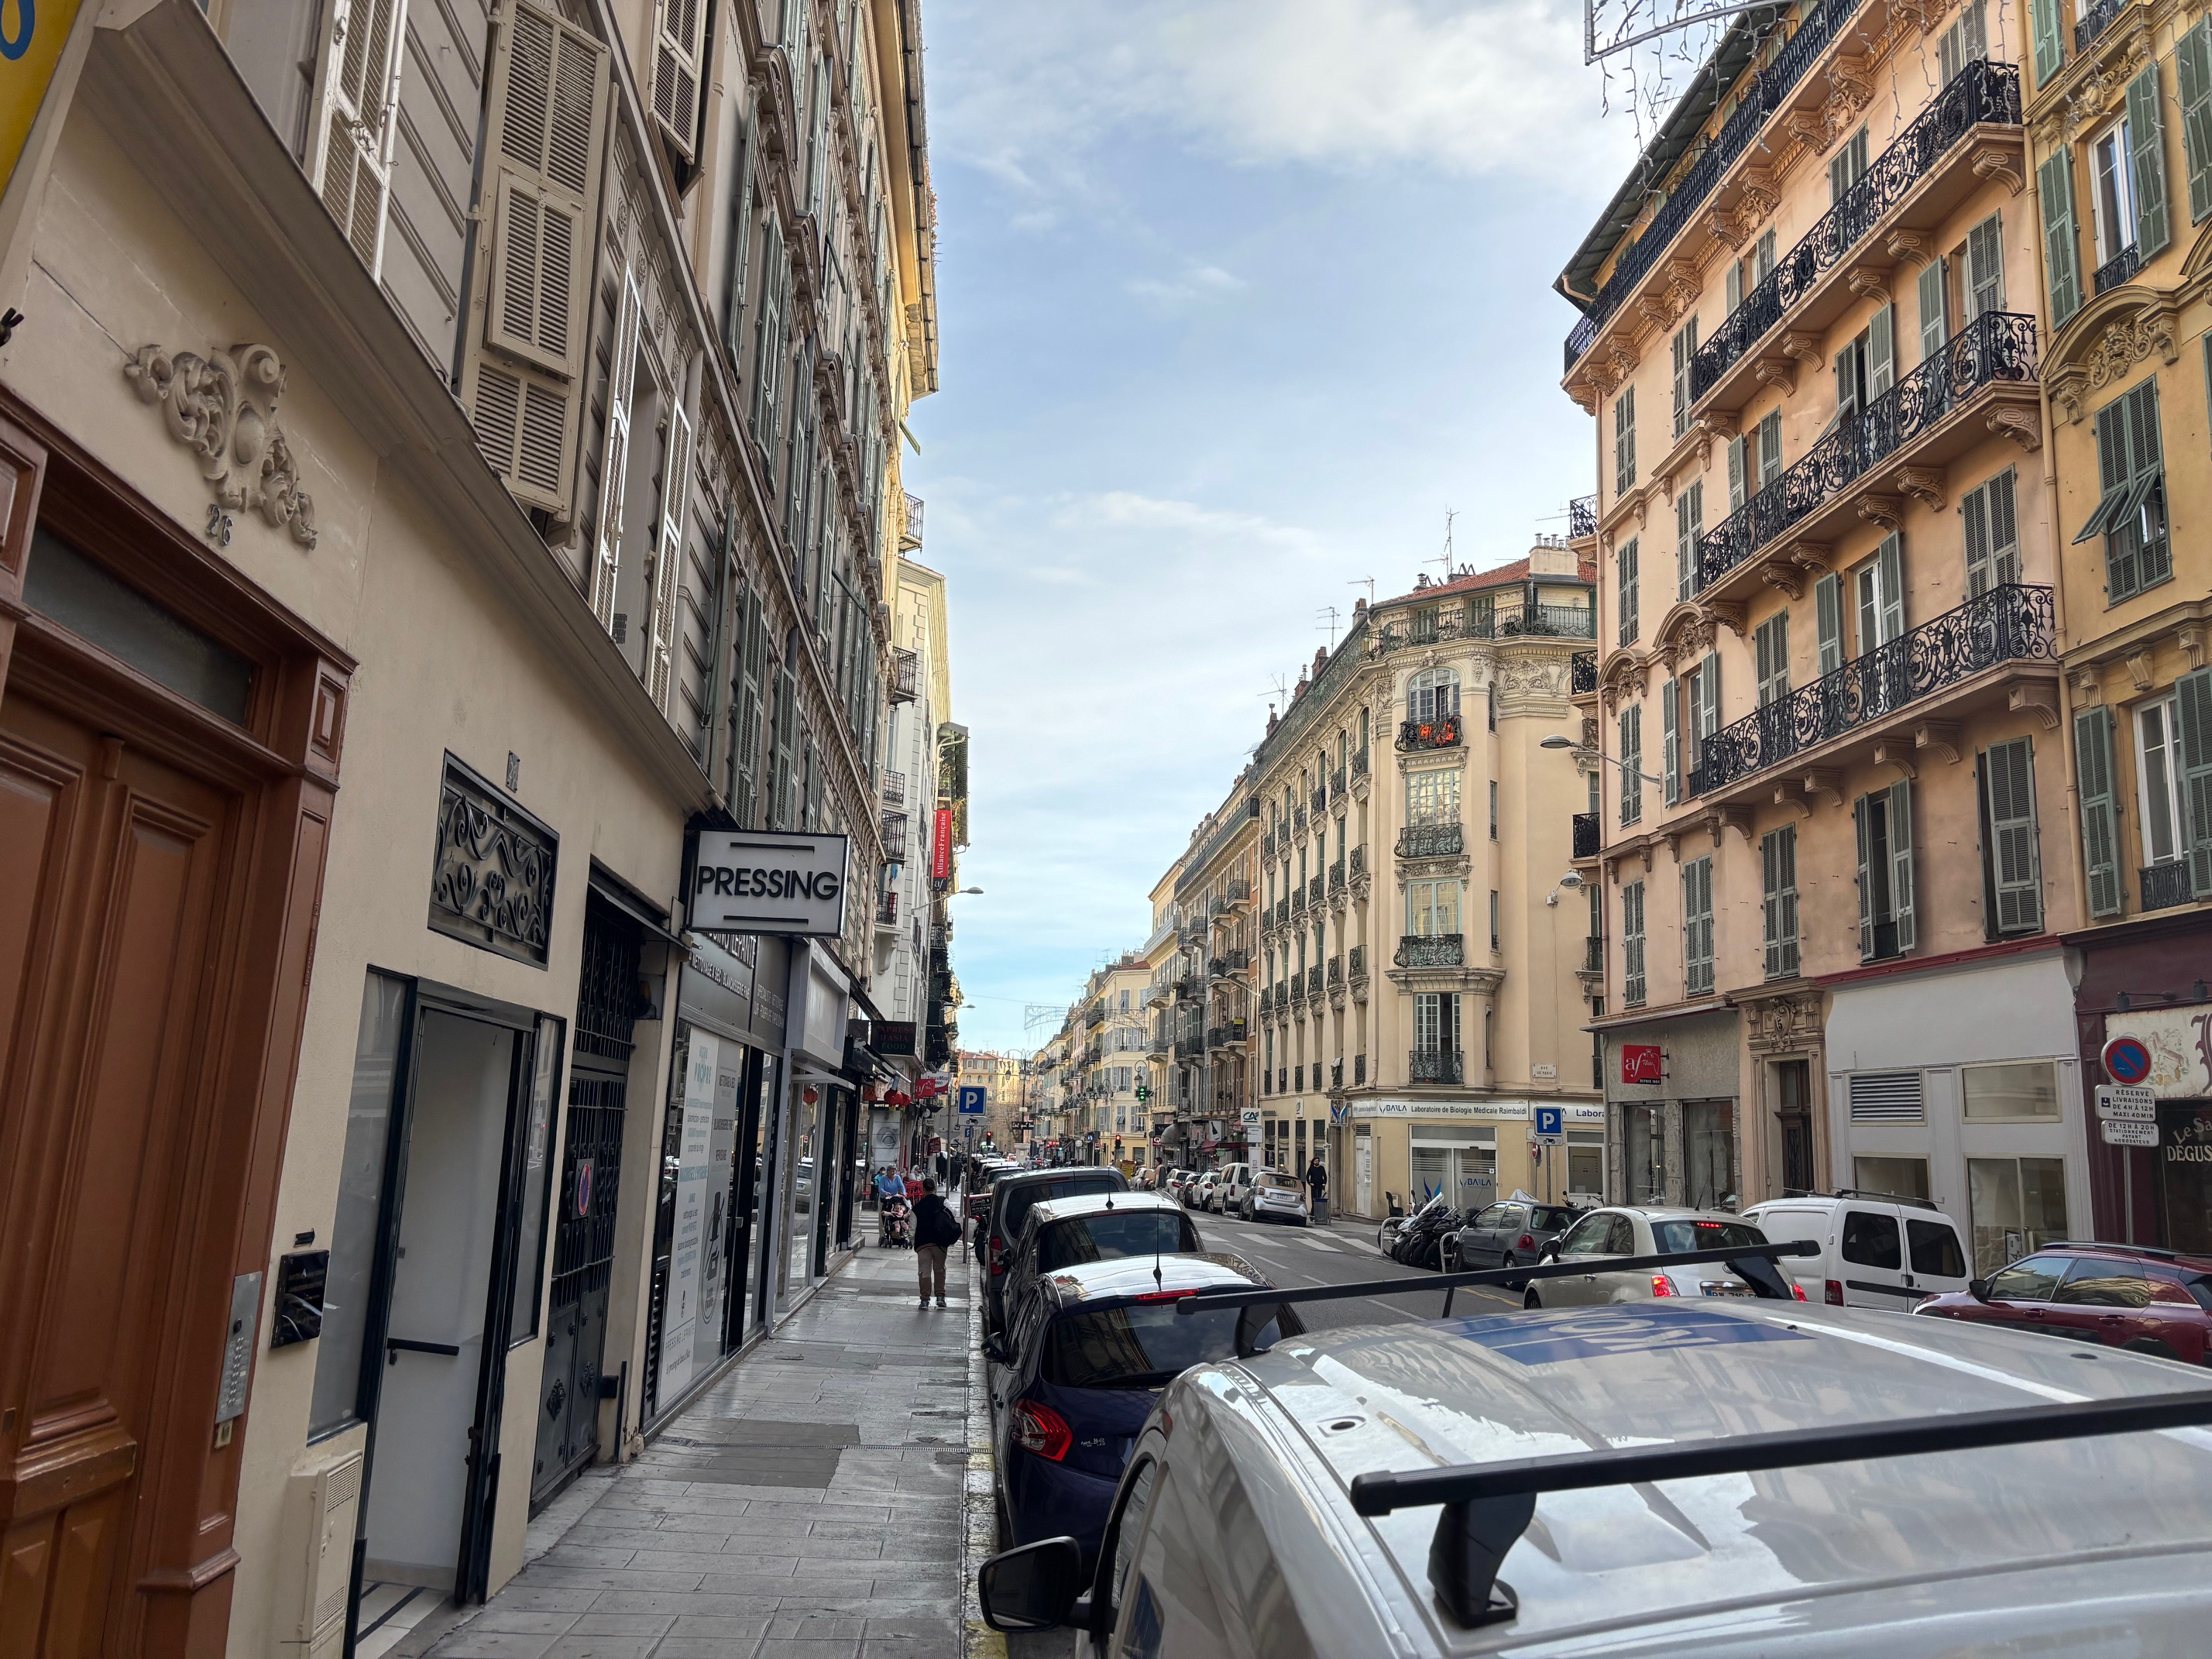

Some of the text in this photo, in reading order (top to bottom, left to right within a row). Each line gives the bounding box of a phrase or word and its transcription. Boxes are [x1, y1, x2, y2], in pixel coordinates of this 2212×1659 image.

[208, 504, 234, 545] 26
[697, 865, 840, 901] PRESSING
[881, 1042, 906, 1050] FOOD
[965, 1091, 977, 1108] P
[1450, 1106, 1472, 1115] Biologie
[1474, 1106, 1498, 1115] Médicale
[1542, 1112, 1555, 1130] P
[2172, 1126, 2193, 1145] Le
[1467, 1178, 1492, 1187] BARLA
